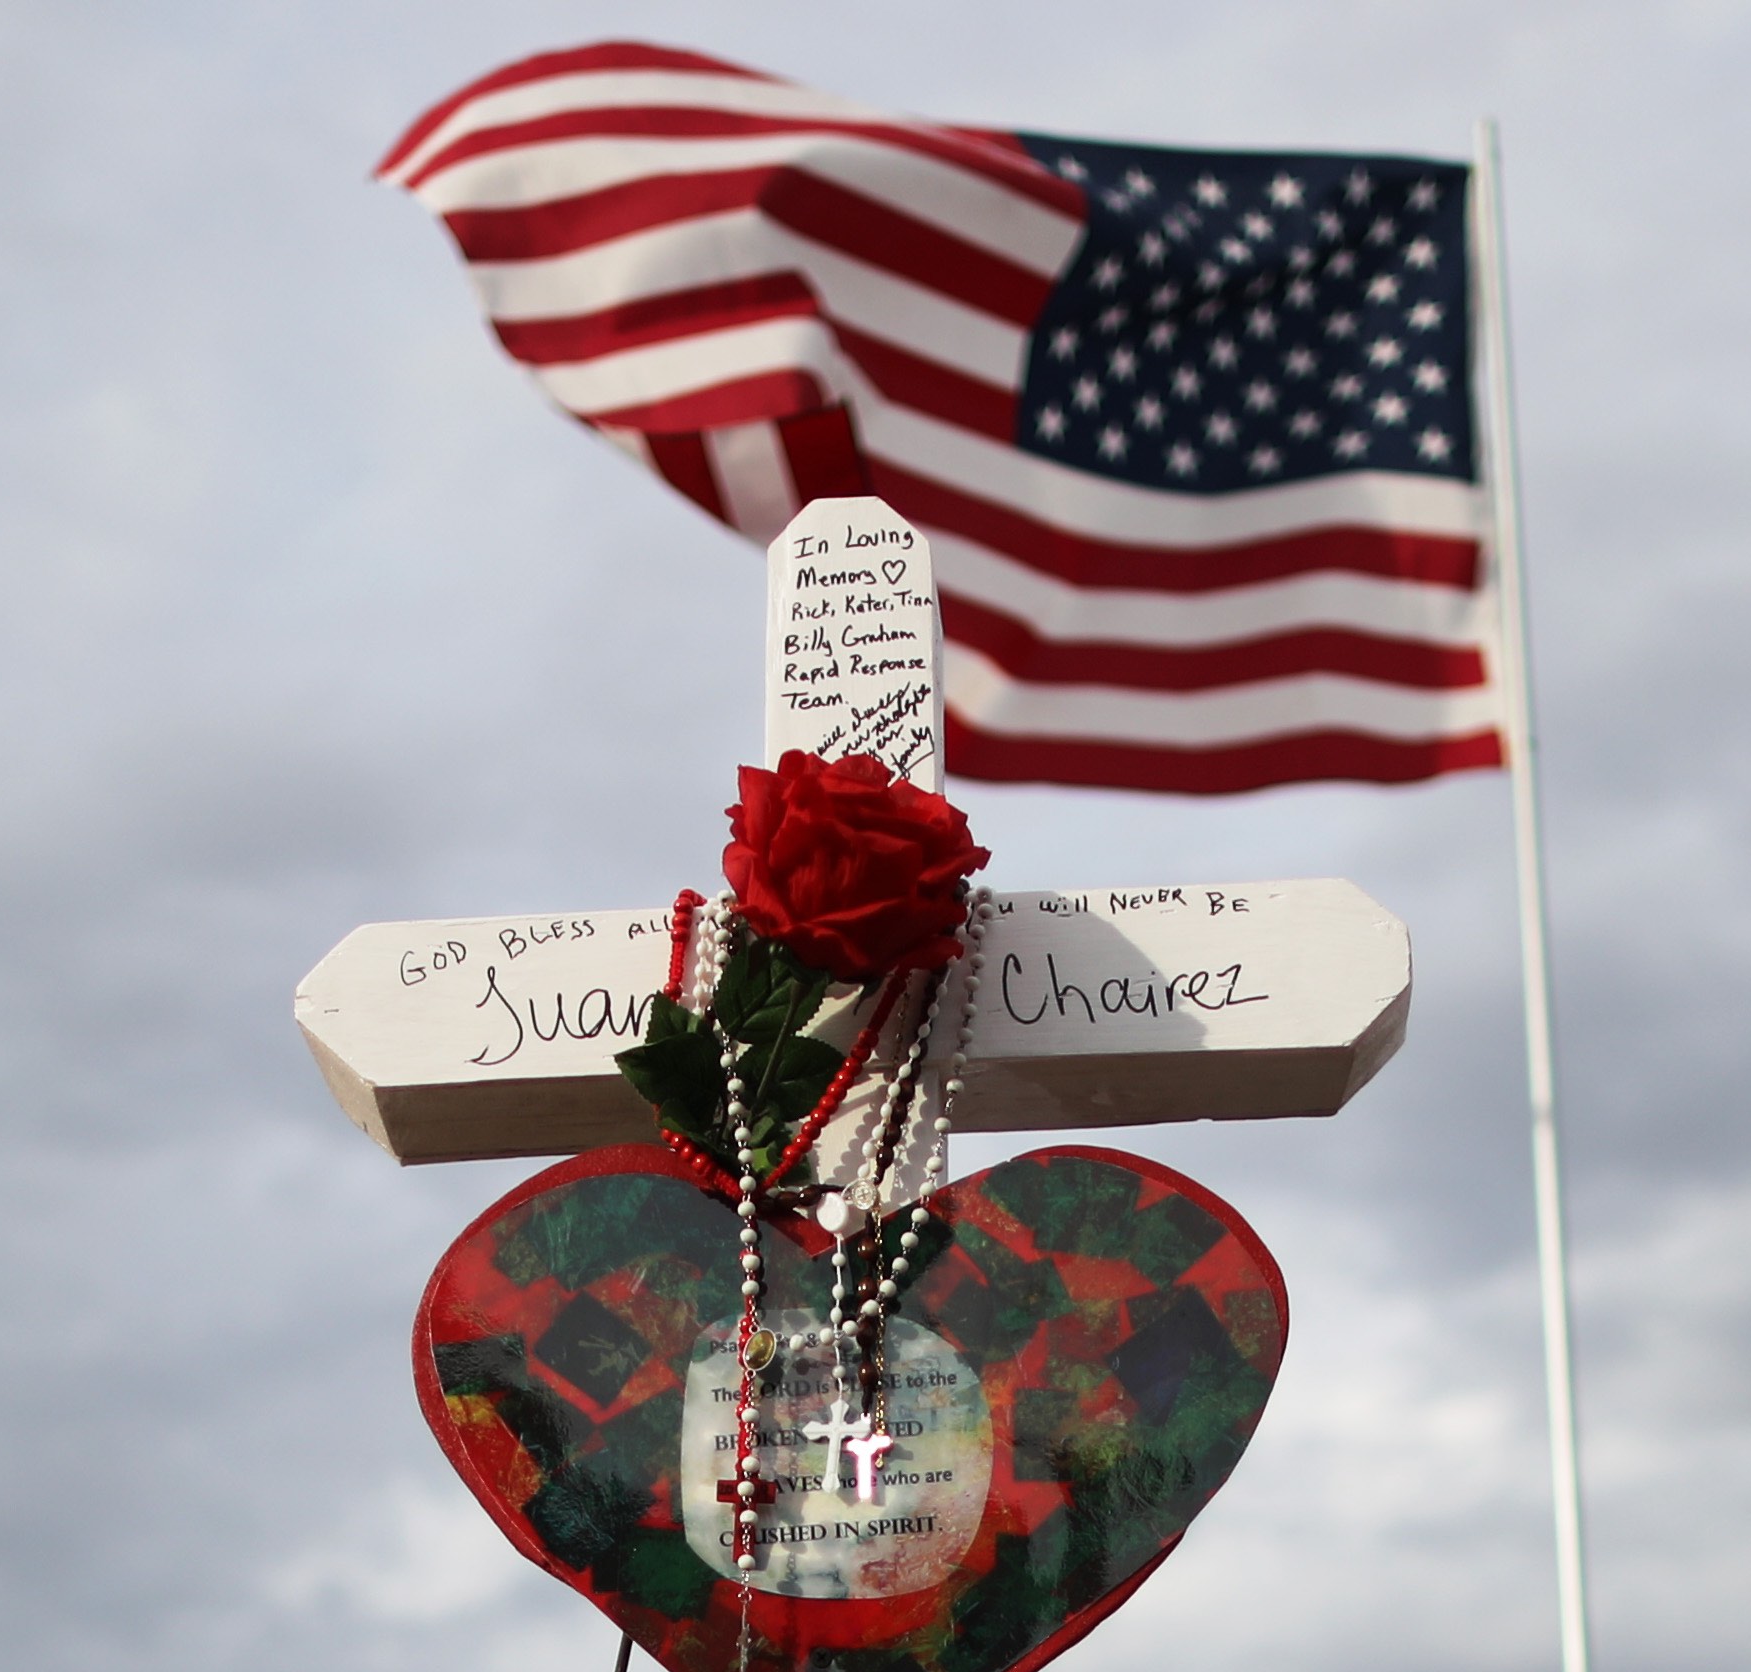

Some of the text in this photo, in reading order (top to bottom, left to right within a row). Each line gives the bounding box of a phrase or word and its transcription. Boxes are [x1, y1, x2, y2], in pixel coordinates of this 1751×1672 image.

[794, 525, 914, 559] In Loving
[796, 566, 877, 589] Memory
[792, 598, 836, 622] Rick,
[785, 623, 917, 657] Billy Graham
[784, 654, 926, 684] Rapid Response
[781, 692, 850, 710] Team.
[1110, 888, 1189, 914] NEVER
[1207, 890, 1250, 916] BE
[399, 941, 468, 986] GOD
[499, 919, 596, 959] BLESS
[711, 1388, 740, 1403] The
[834, 1371, 903, 1393] CLSE
[907, 1375, 923, 1388] to
[929, 1372, 957, 1387] the
[774, 1478, 822, 1495] AVES
[882, 1474, 921, 1487] who
[925, 1470, 953, 1483] are
[719, 1515, 944, 1549] CUSHED IN SPIRIT.
